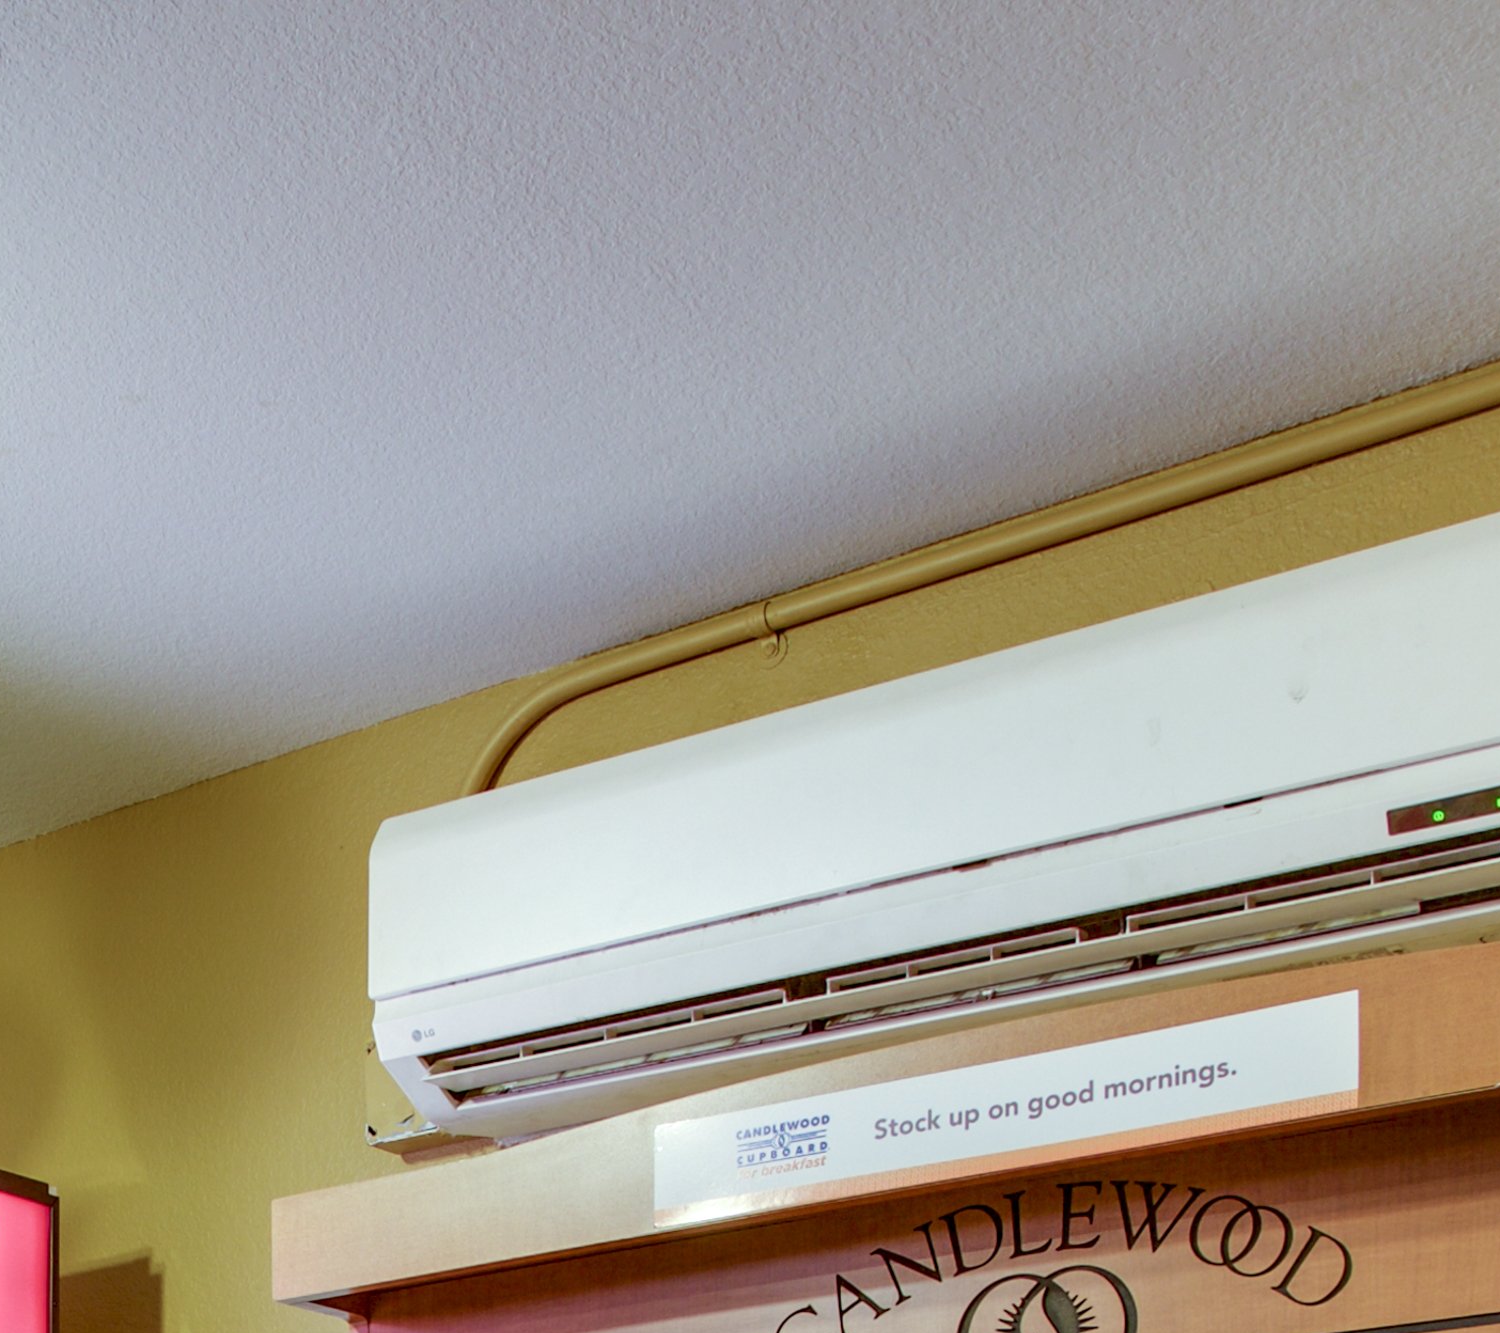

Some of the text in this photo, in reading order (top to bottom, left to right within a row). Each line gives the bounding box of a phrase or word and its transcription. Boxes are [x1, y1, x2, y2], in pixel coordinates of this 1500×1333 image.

[873, 1055, 1238, 1144] Stock up on good mornings.
[736, 1114, 831, 1141] CANDLEWOOD
[737, 1141, 829, 1165] CUPBOARD
[761, 1155, 827, 1178] breakfast
